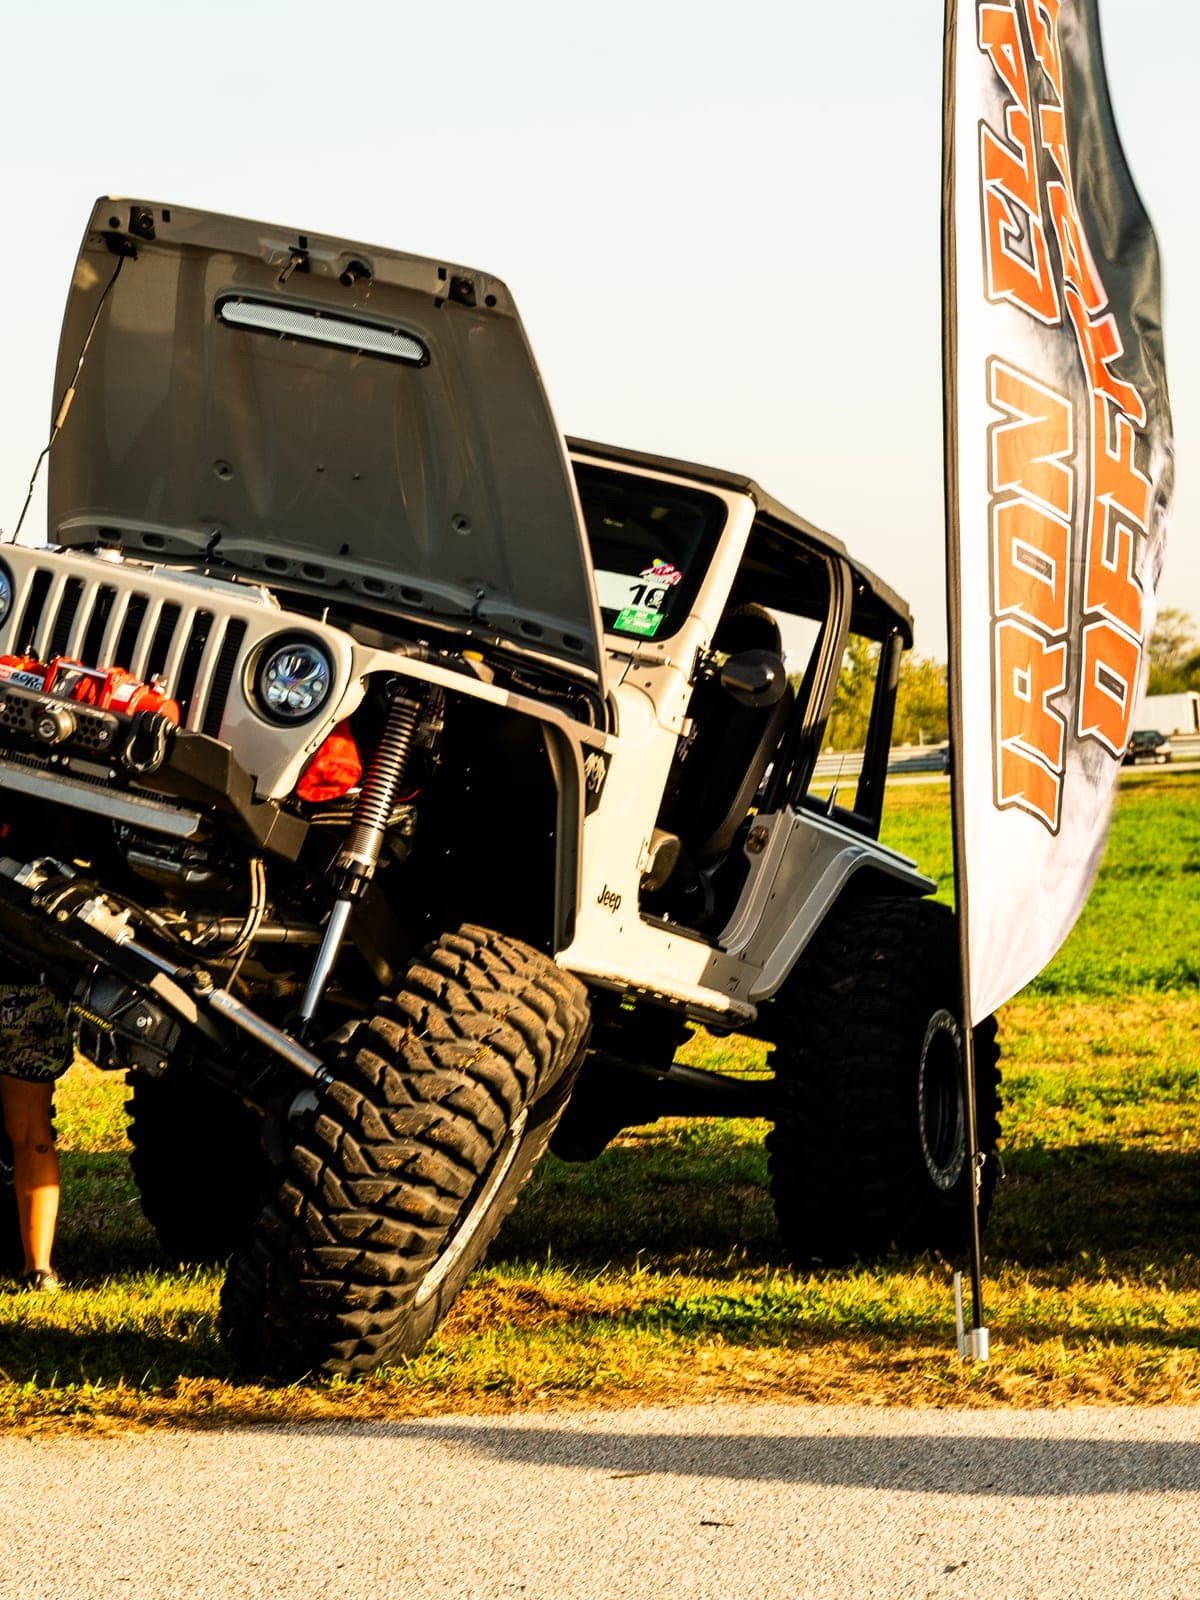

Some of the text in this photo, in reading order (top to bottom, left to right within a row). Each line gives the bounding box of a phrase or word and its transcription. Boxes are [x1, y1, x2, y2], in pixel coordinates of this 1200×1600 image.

[977, 0, 1077, 834] IRON CLA
[597, 883, 622, 914] Jeep
